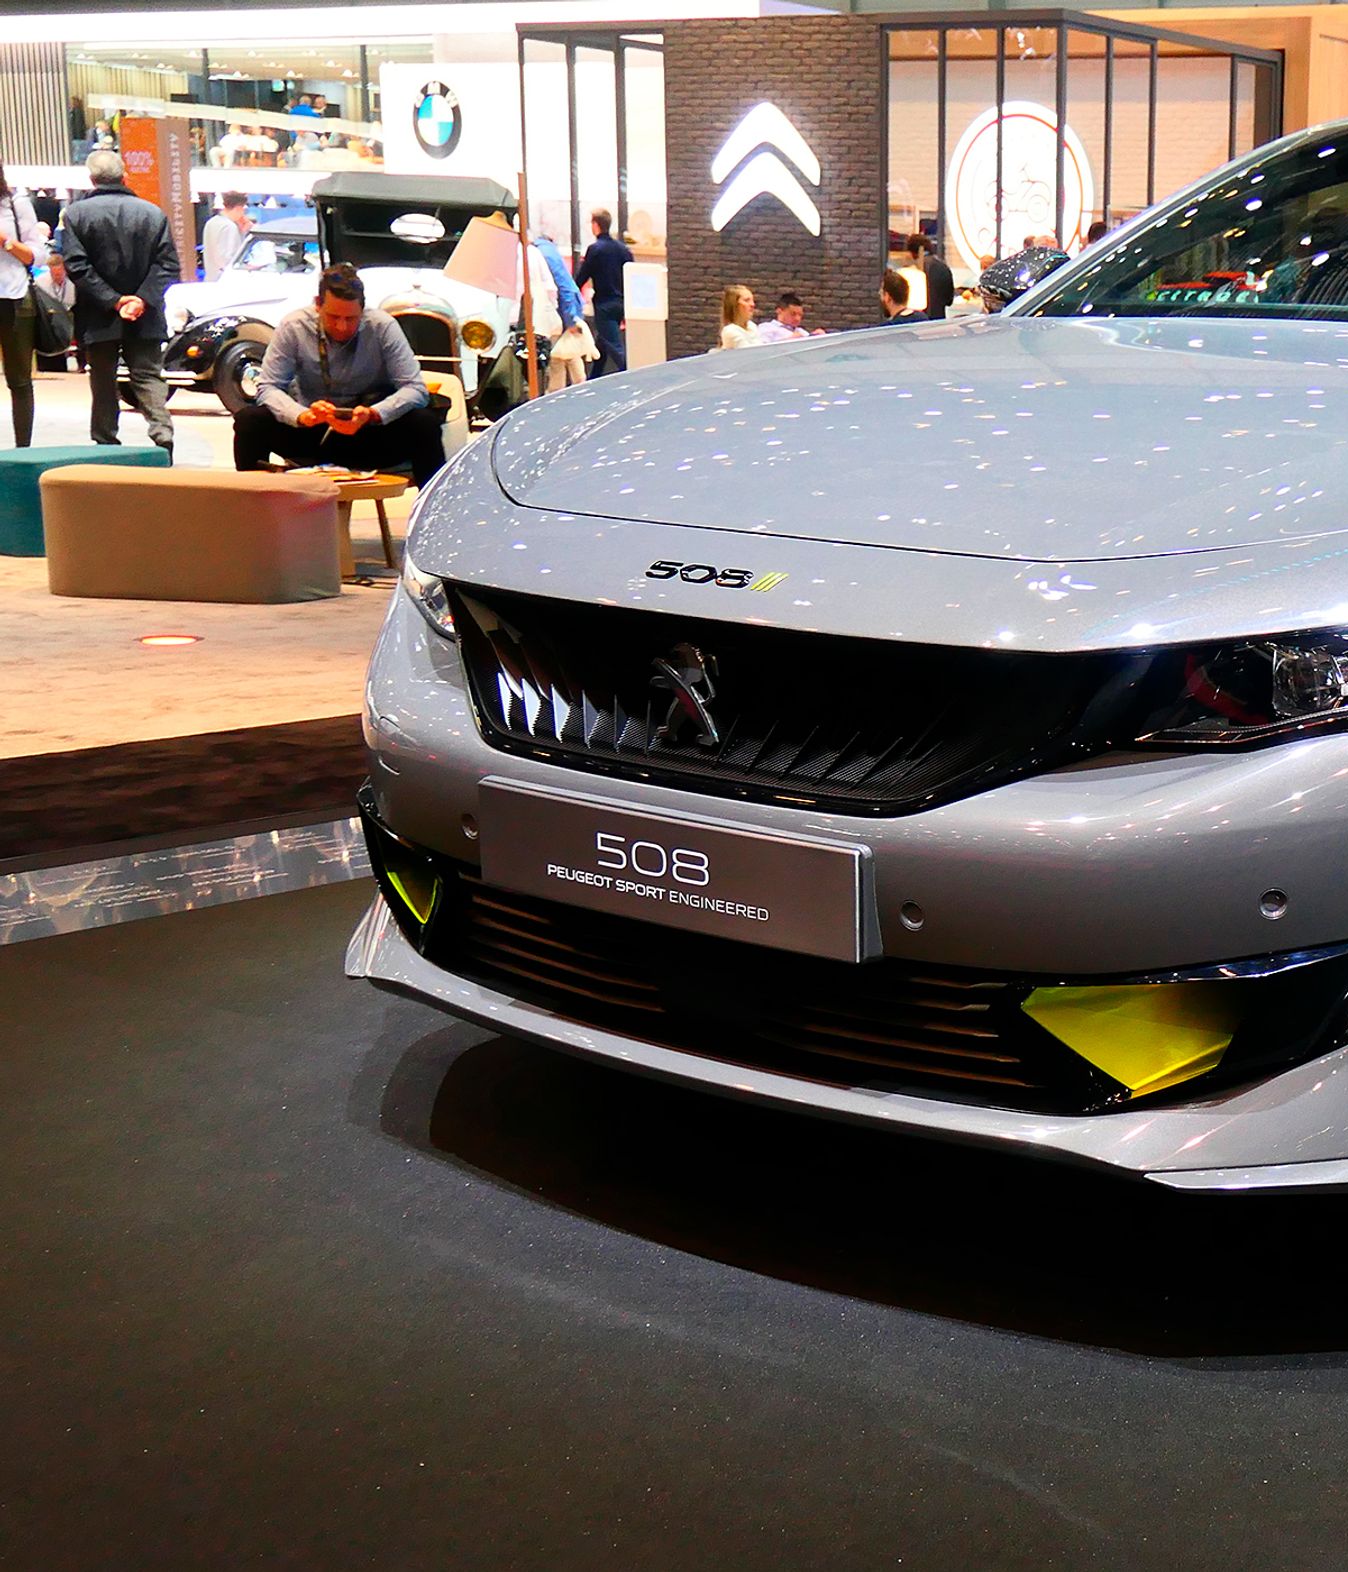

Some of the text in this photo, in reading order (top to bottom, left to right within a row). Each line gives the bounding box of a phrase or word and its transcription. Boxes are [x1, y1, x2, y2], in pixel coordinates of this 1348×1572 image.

[645, 560, 754, 589] 508
[596, 832, 710, 887] 508
[547, 863, 770, 922] PEUGEOT SPORT ENGINEERED
